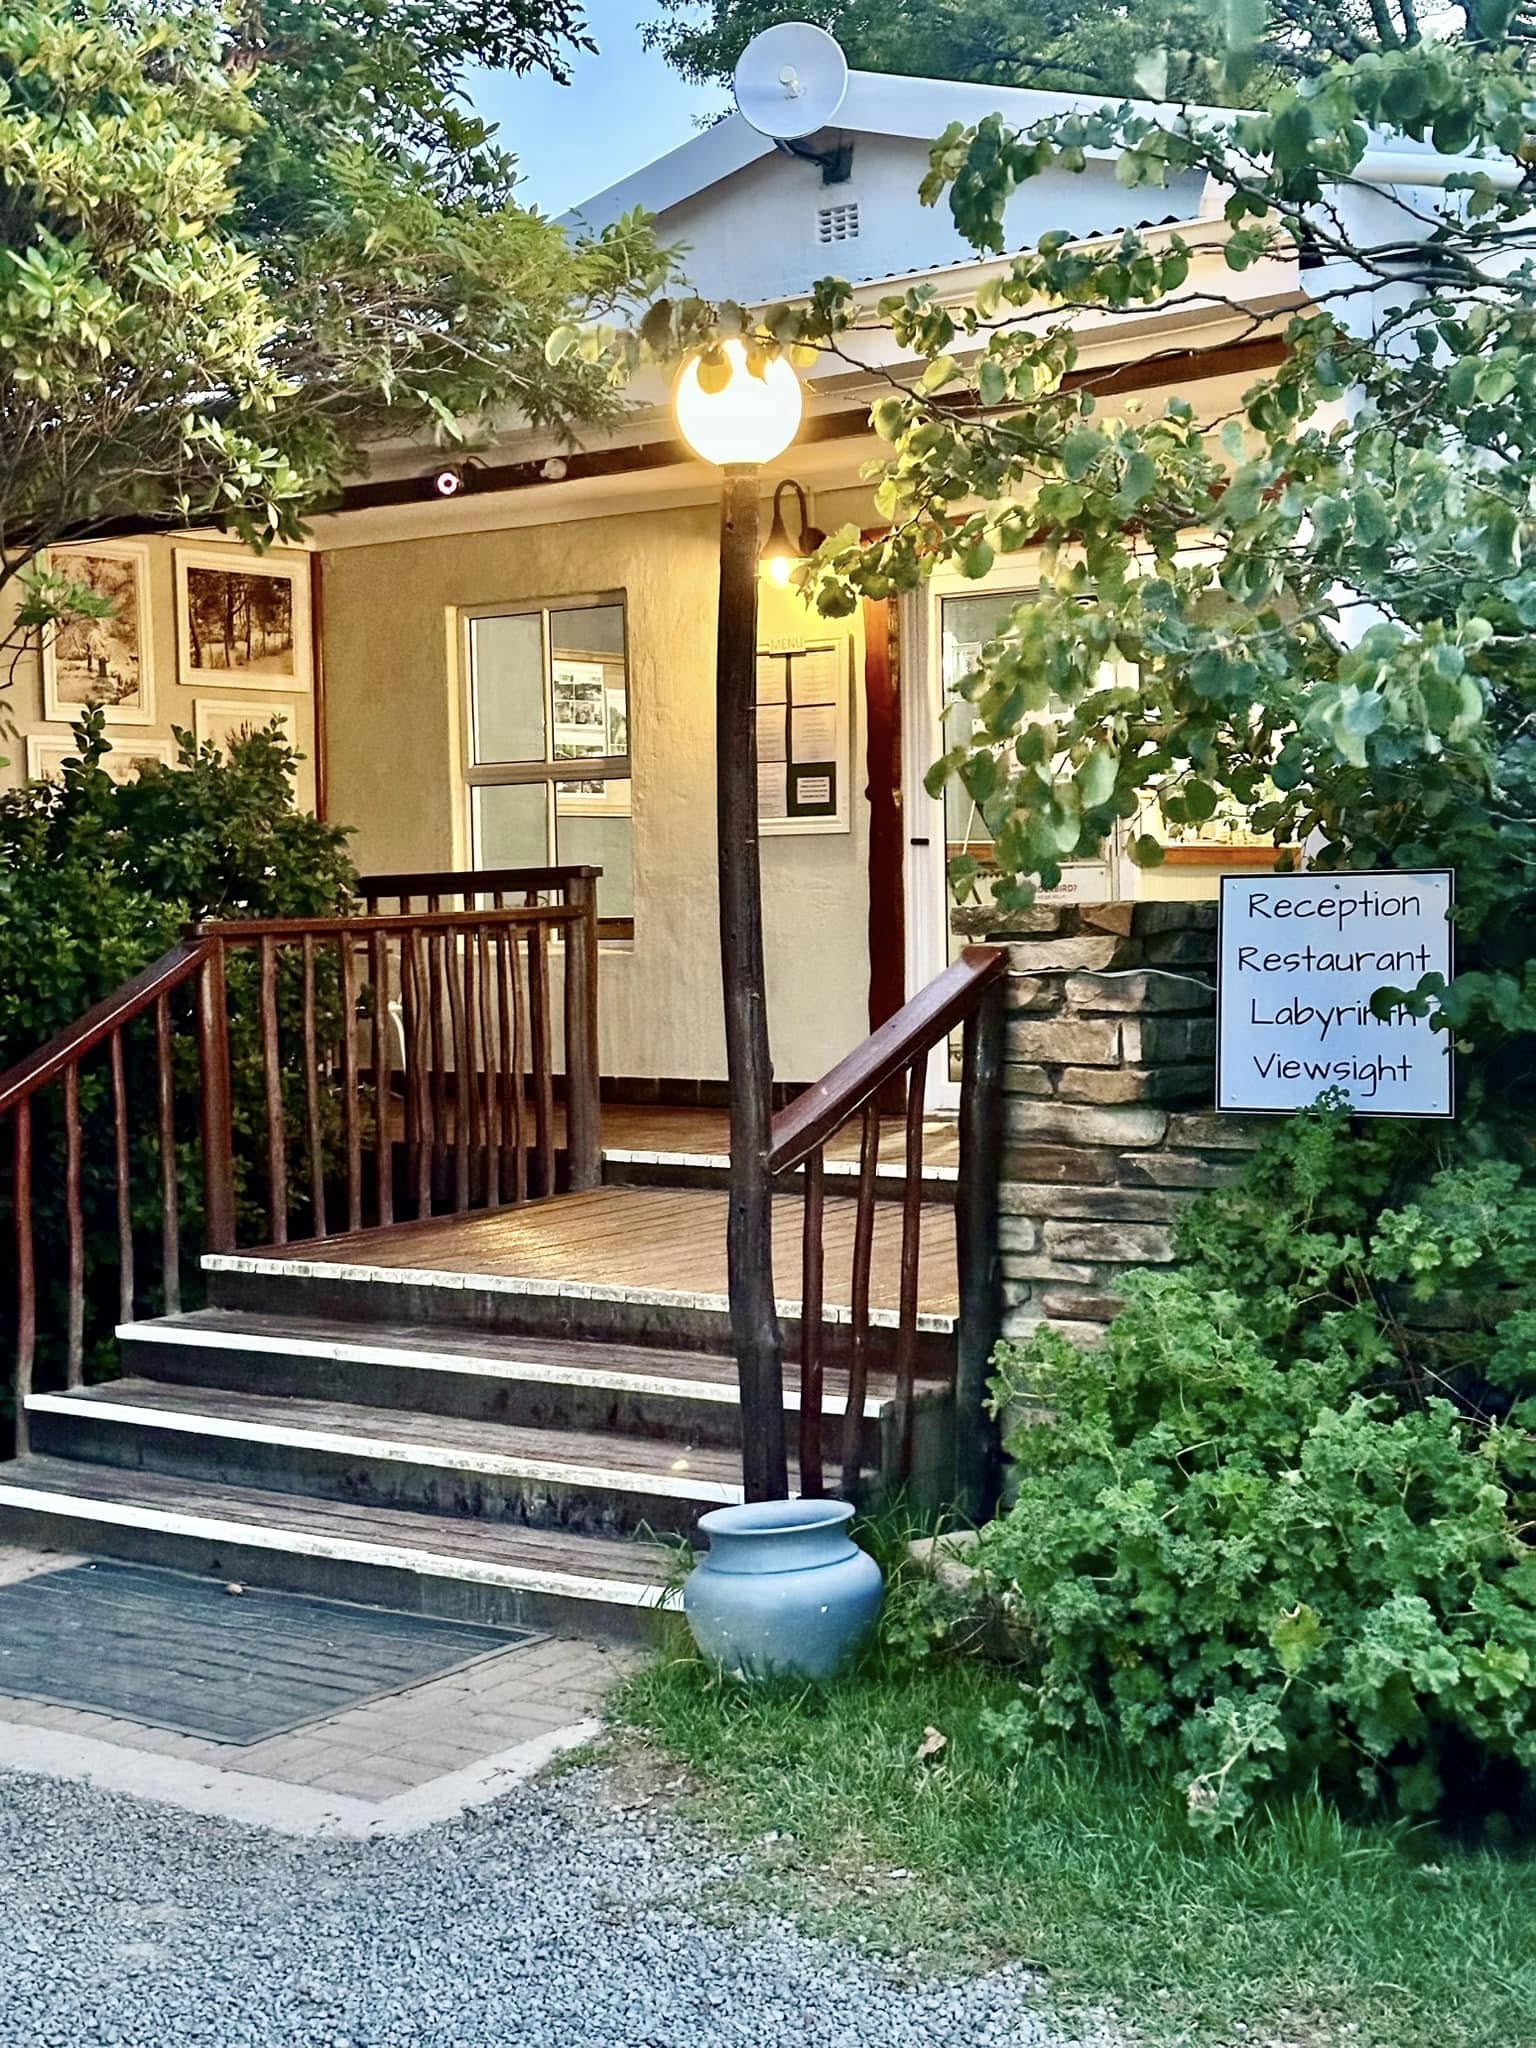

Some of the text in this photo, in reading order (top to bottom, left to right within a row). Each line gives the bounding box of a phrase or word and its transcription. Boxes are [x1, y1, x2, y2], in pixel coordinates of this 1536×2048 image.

[770, 637, 803, 650] MENU
[1249, 890, 1420, 931] Reception
[1238, 944, 1431, 972] Restaurant
[1253, 1053, 1413, 1096] Viewsight
